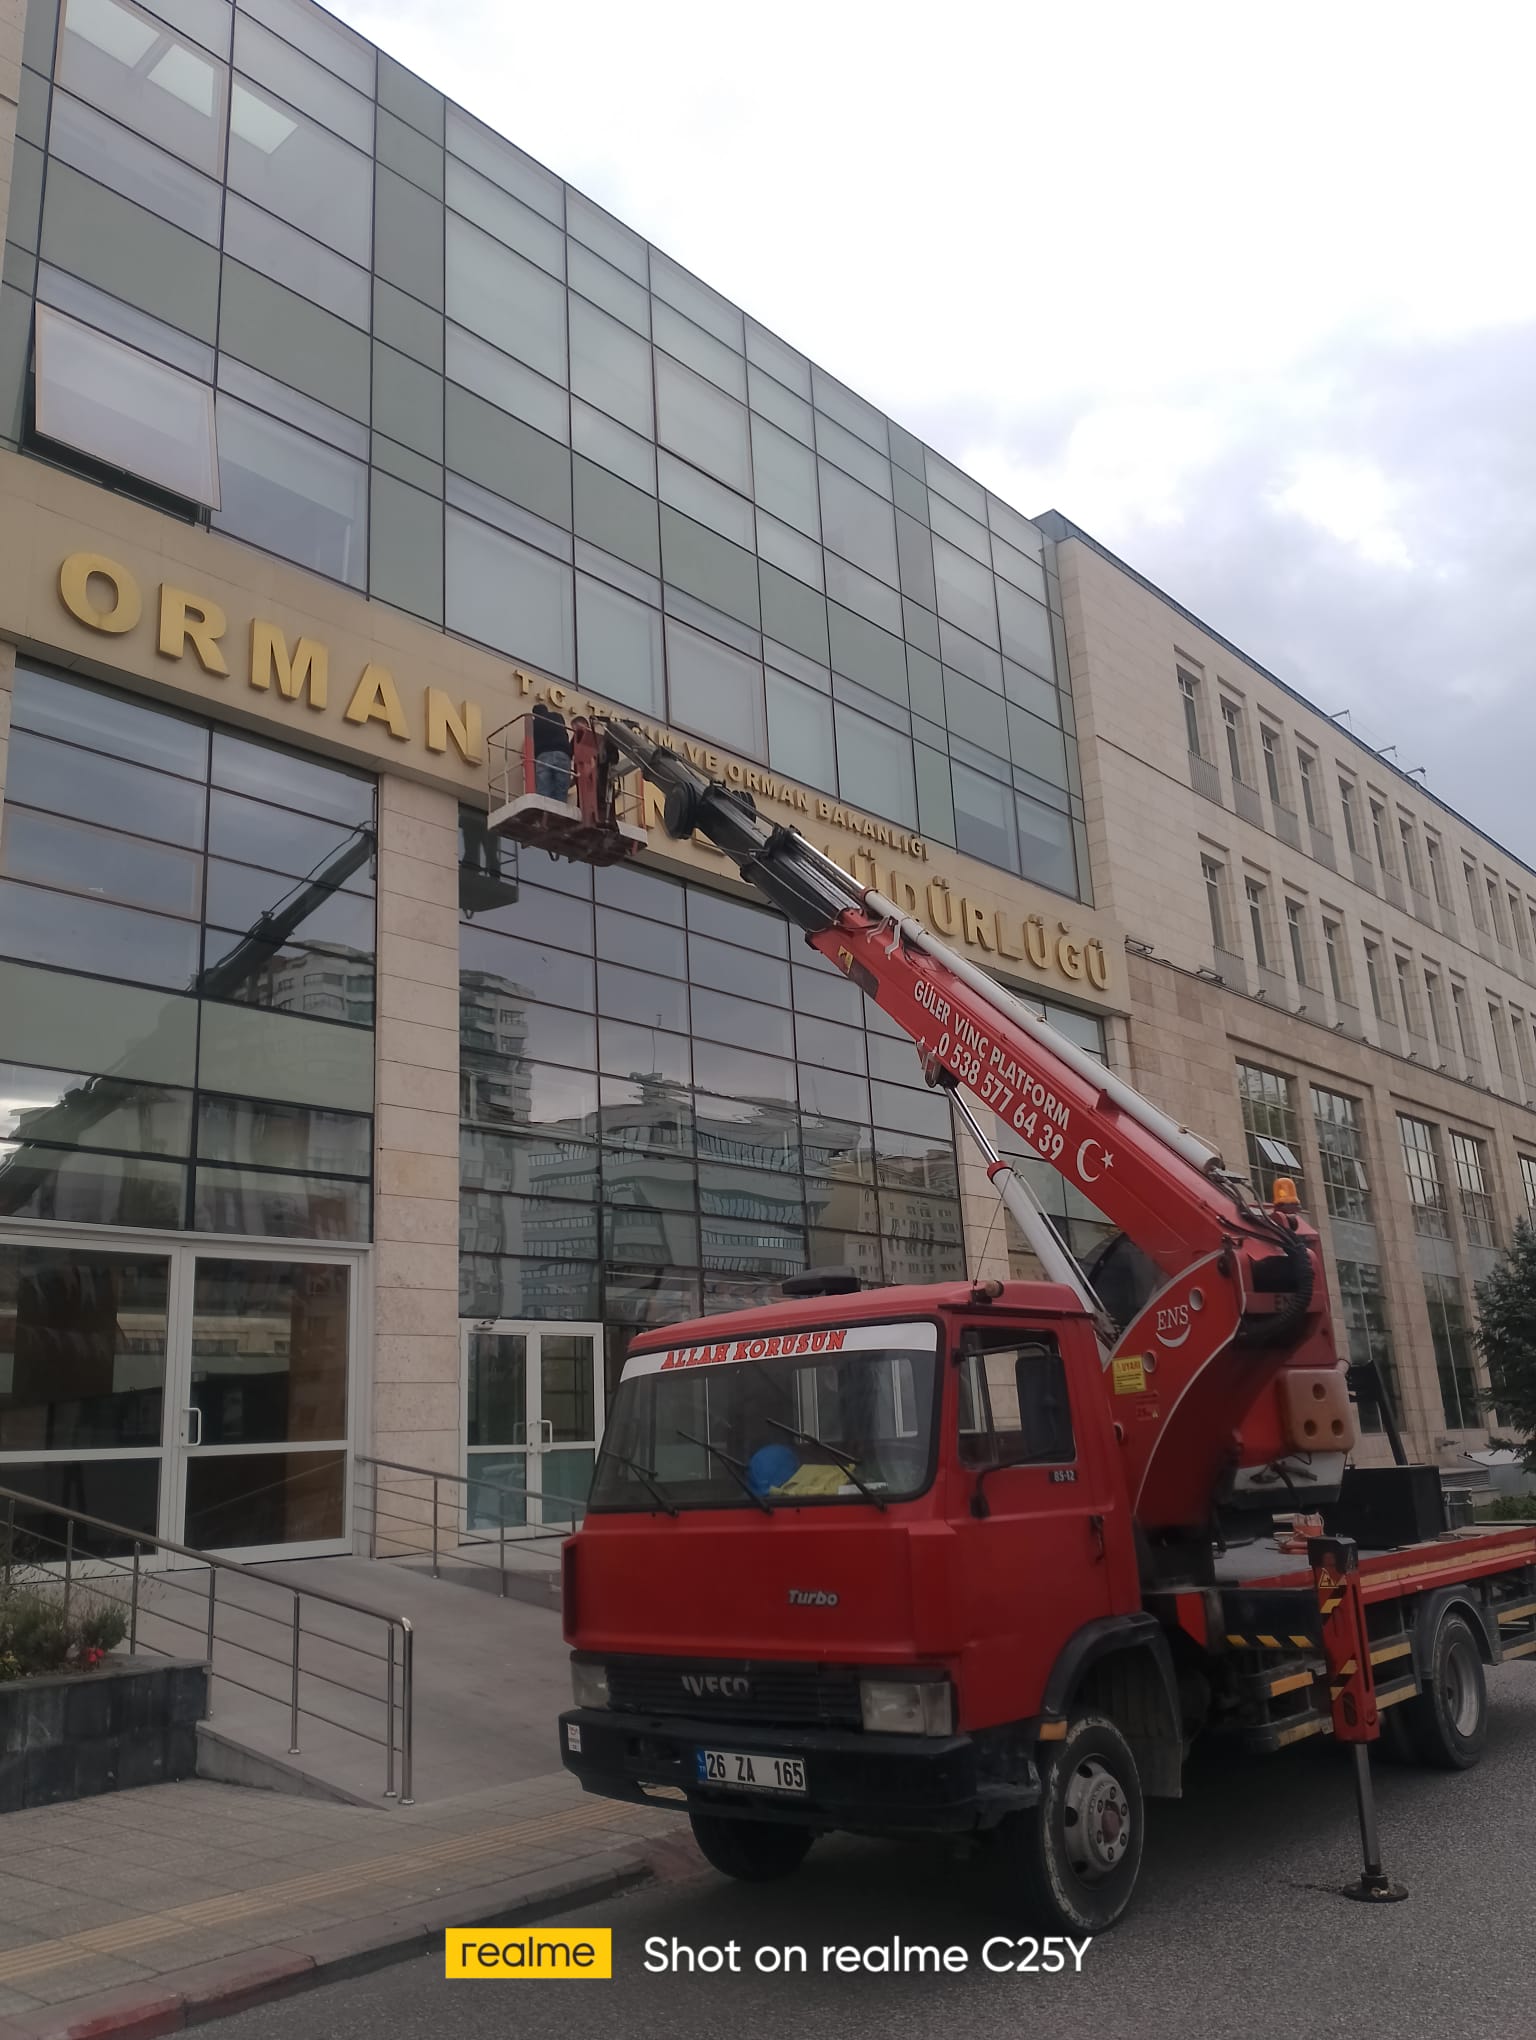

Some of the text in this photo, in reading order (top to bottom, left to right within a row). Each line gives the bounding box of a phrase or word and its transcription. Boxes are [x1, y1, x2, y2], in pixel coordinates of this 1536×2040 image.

[58, 552, 1111, 991] ORMAN ÜDÜRLÜĞÜ
[684, 742, 718, 774] VE
[726, 762, 808, 813] ORMAN
[914, 980, 1071, 1131] GÜLER VİNÇ PLATFORM
[938, 1033, 1065, 1161] 0 538 577 64 39
[1156, 1305, 1190, 1332] ENS
[660, 1330, 847, 1370] ALLAH KORUSUN
[788, 1589, 839, 1606] Turbo
[681, 1675, 749, 1697] IVECO
[707, 1753, 804, 1788] 26 ZA 165
